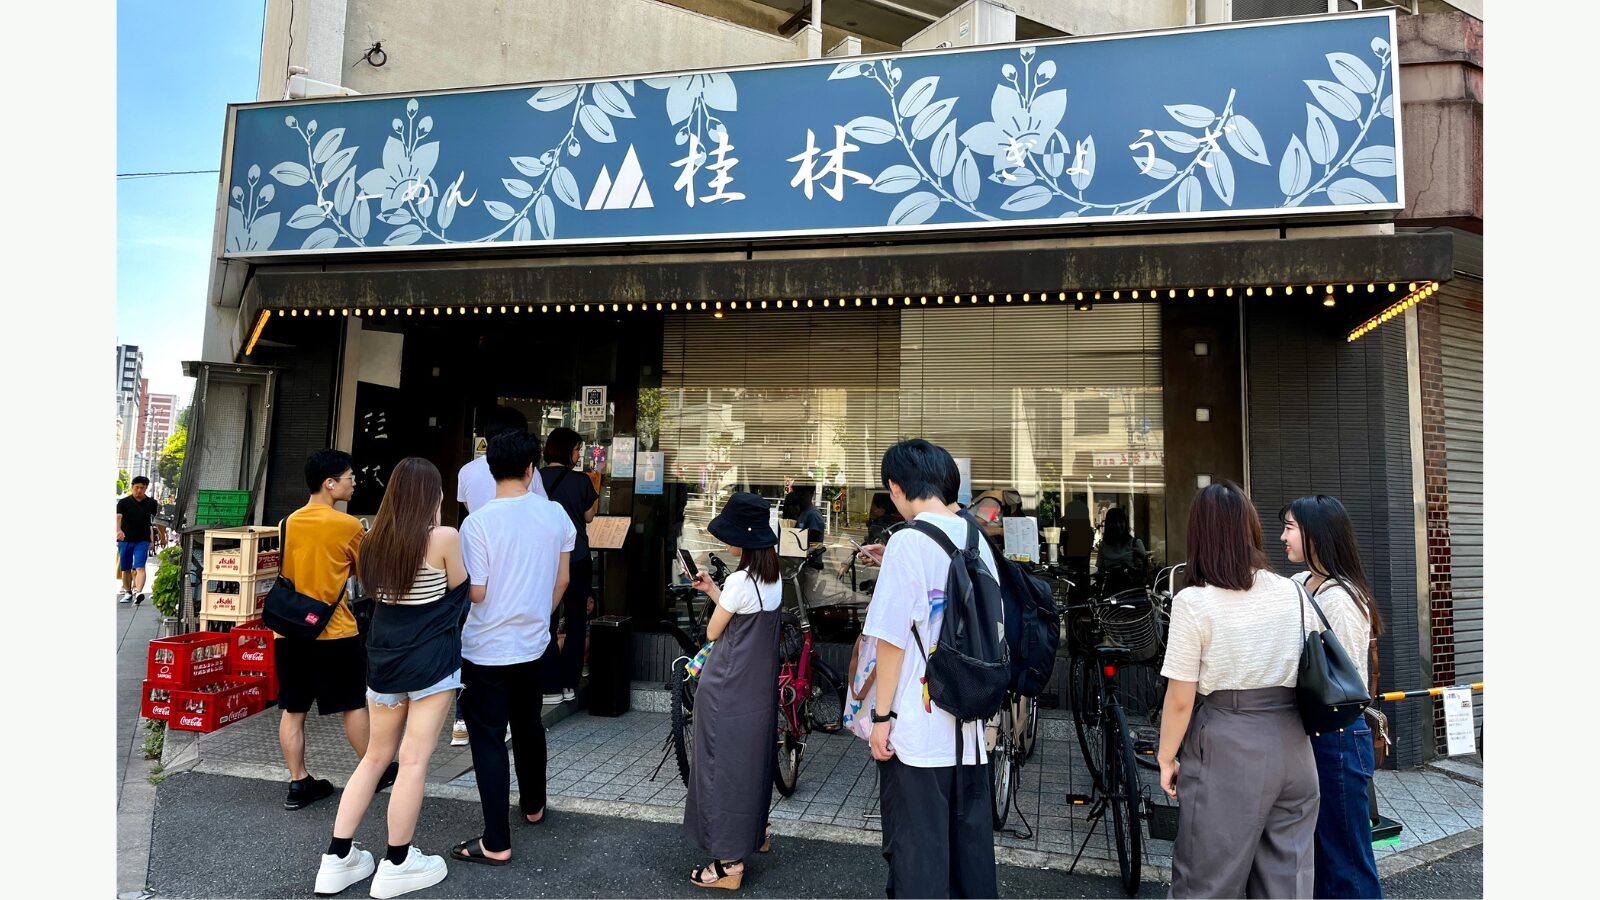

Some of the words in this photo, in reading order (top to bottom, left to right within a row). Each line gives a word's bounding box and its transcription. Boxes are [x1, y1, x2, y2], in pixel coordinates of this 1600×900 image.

[669, 124, 874, 208] 桂林
[1001, 123, 1237, 181] ぎょうざ
[317, 169, 479, 217] らーめん
[218, 557, 236, 565] Asahi
